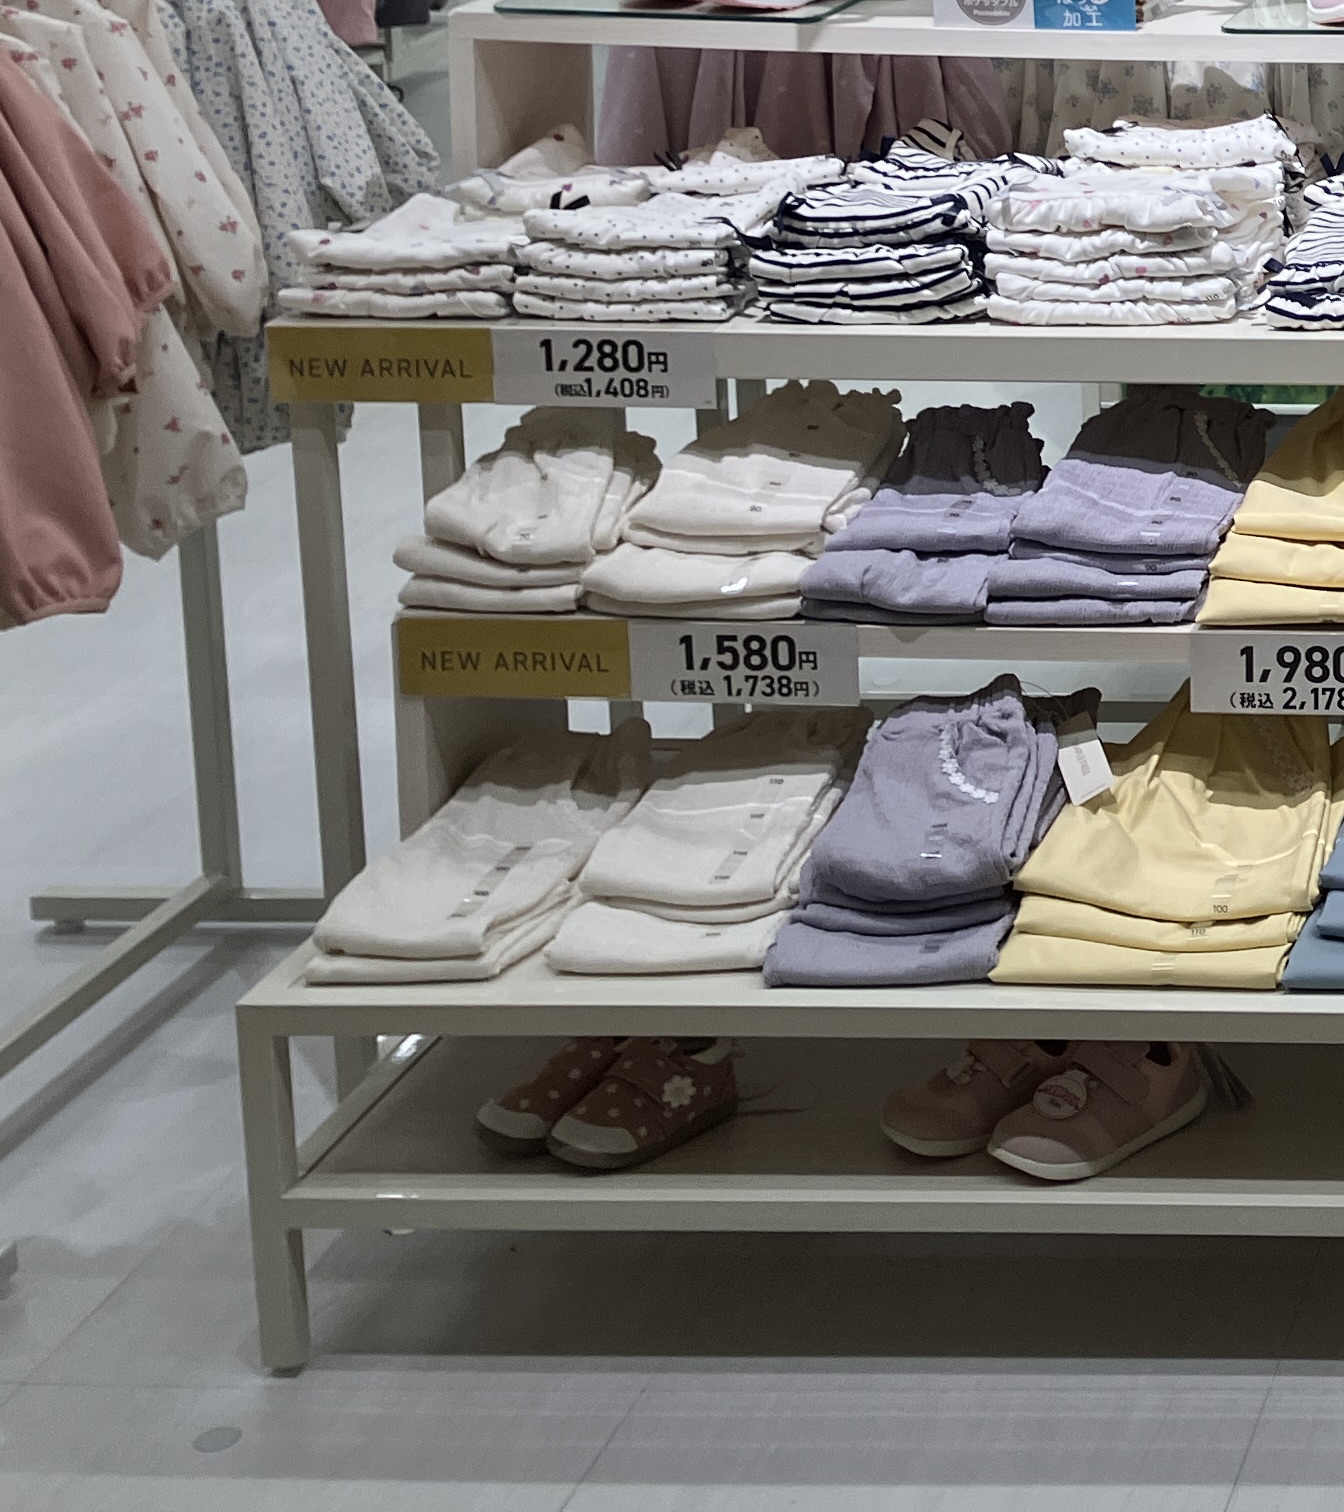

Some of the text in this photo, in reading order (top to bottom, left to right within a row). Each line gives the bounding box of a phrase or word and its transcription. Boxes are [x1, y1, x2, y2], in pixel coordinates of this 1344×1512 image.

[1063, 9, 1103, 27] 加工
[539, 338, 668, 374] 1,280円
[289, 357, 473, 379] NEW ARRIVAL
[421, 650, 609, 673] NEW ARRIVAL
[679, 633, 817, 672] 1,580円
[1213, 904, 1228, 913] 100
